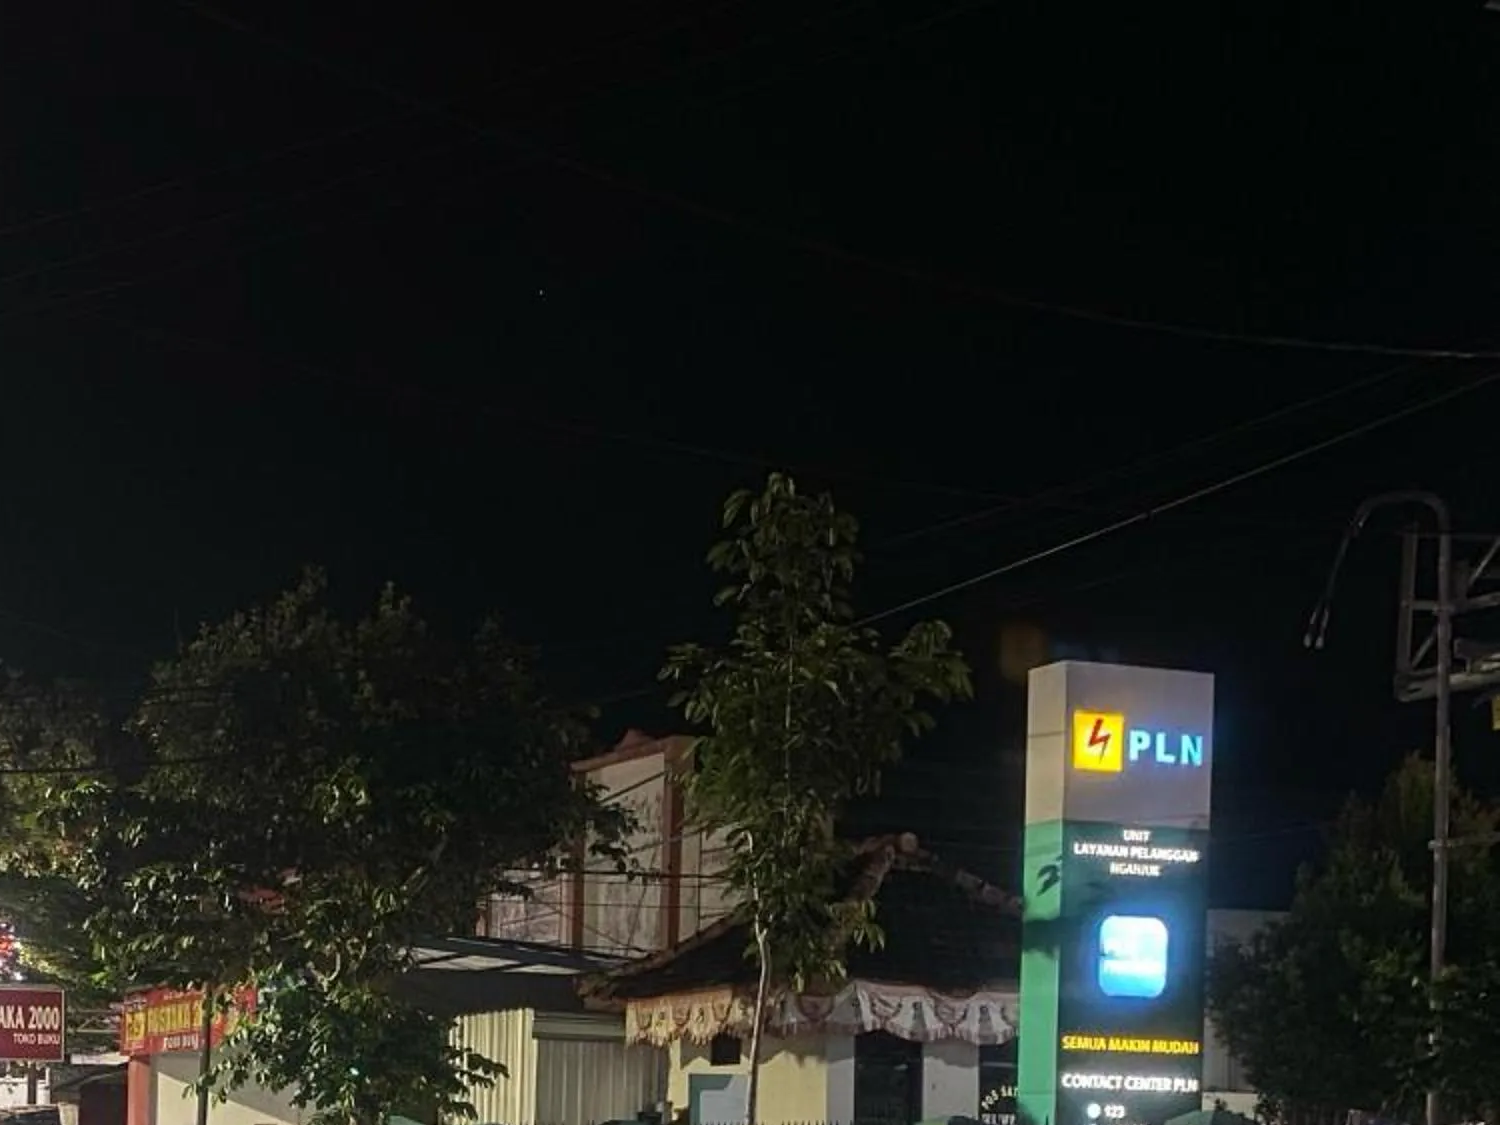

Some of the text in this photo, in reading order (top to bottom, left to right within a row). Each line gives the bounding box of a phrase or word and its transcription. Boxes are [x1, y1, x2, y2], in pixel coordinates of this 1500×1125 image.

[1129, 730, 1203, 766] PLN
[1123, 829, 1151, 842] UNIT
[1074, 843, 1199, 863] LAYANAN PELANGGAN
[28, 1005, 61, 1030] 2000
[13, 1033, 61, 1045] TOKO BUKU
[1062, 1035, 1199, 1055] SEMUA MAKIN MUDAH
[1062, 1073, 1199, 1093] CONTACT CENTER PLN
